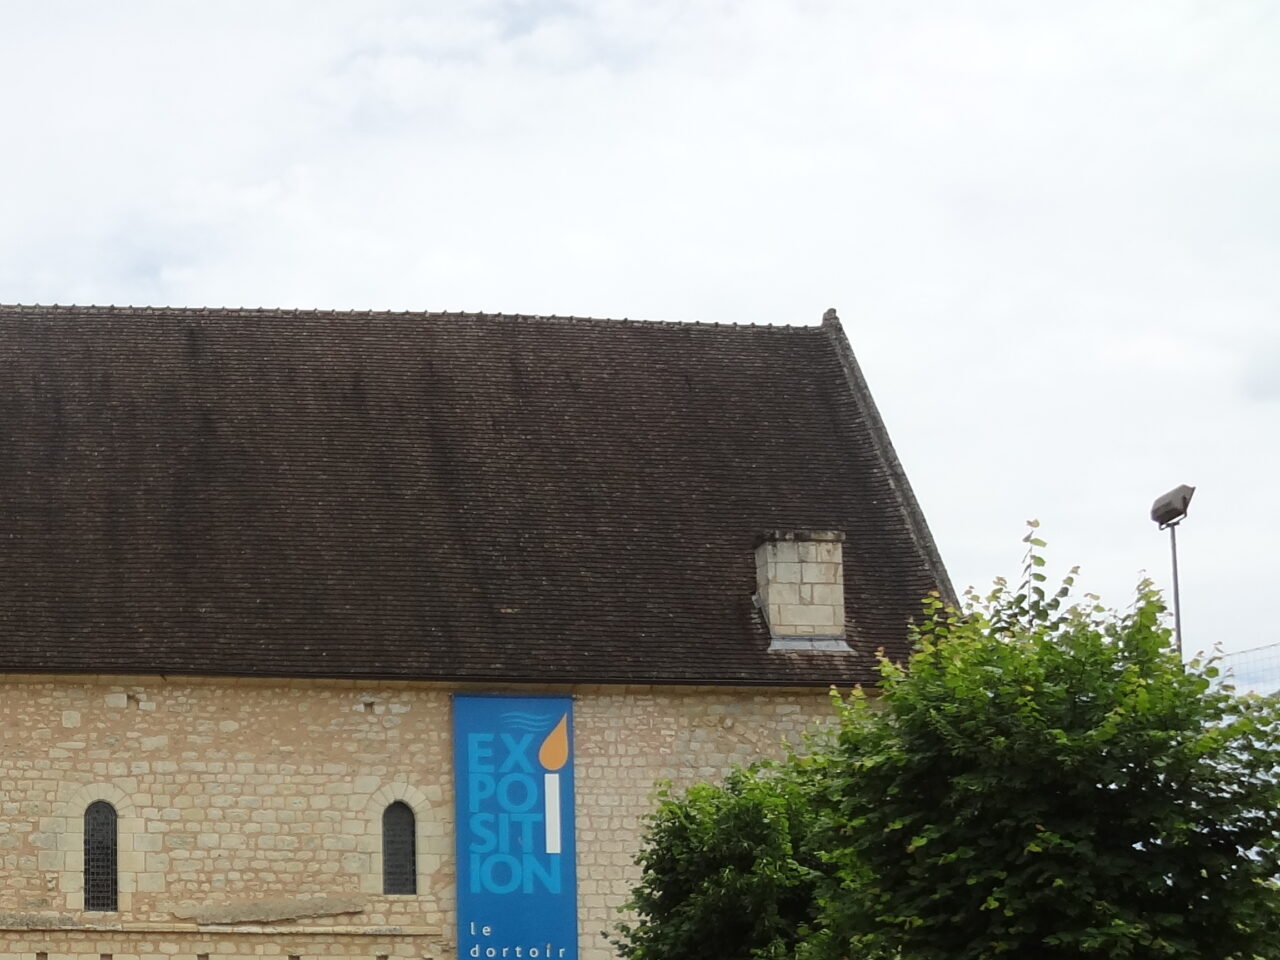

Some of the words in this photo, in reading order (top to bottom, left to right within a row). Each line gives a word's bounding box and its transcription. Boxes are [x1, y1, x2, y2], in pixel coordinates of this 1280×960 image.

[468, 733, 535, 773] EX
[468, 772, 538, 814] PO
[470, 812, 544, 855] SIT
[471, 853, 561, 895] ION
[470, 921, 492, 936] le
[470, 943, 566, 959] dortoir
